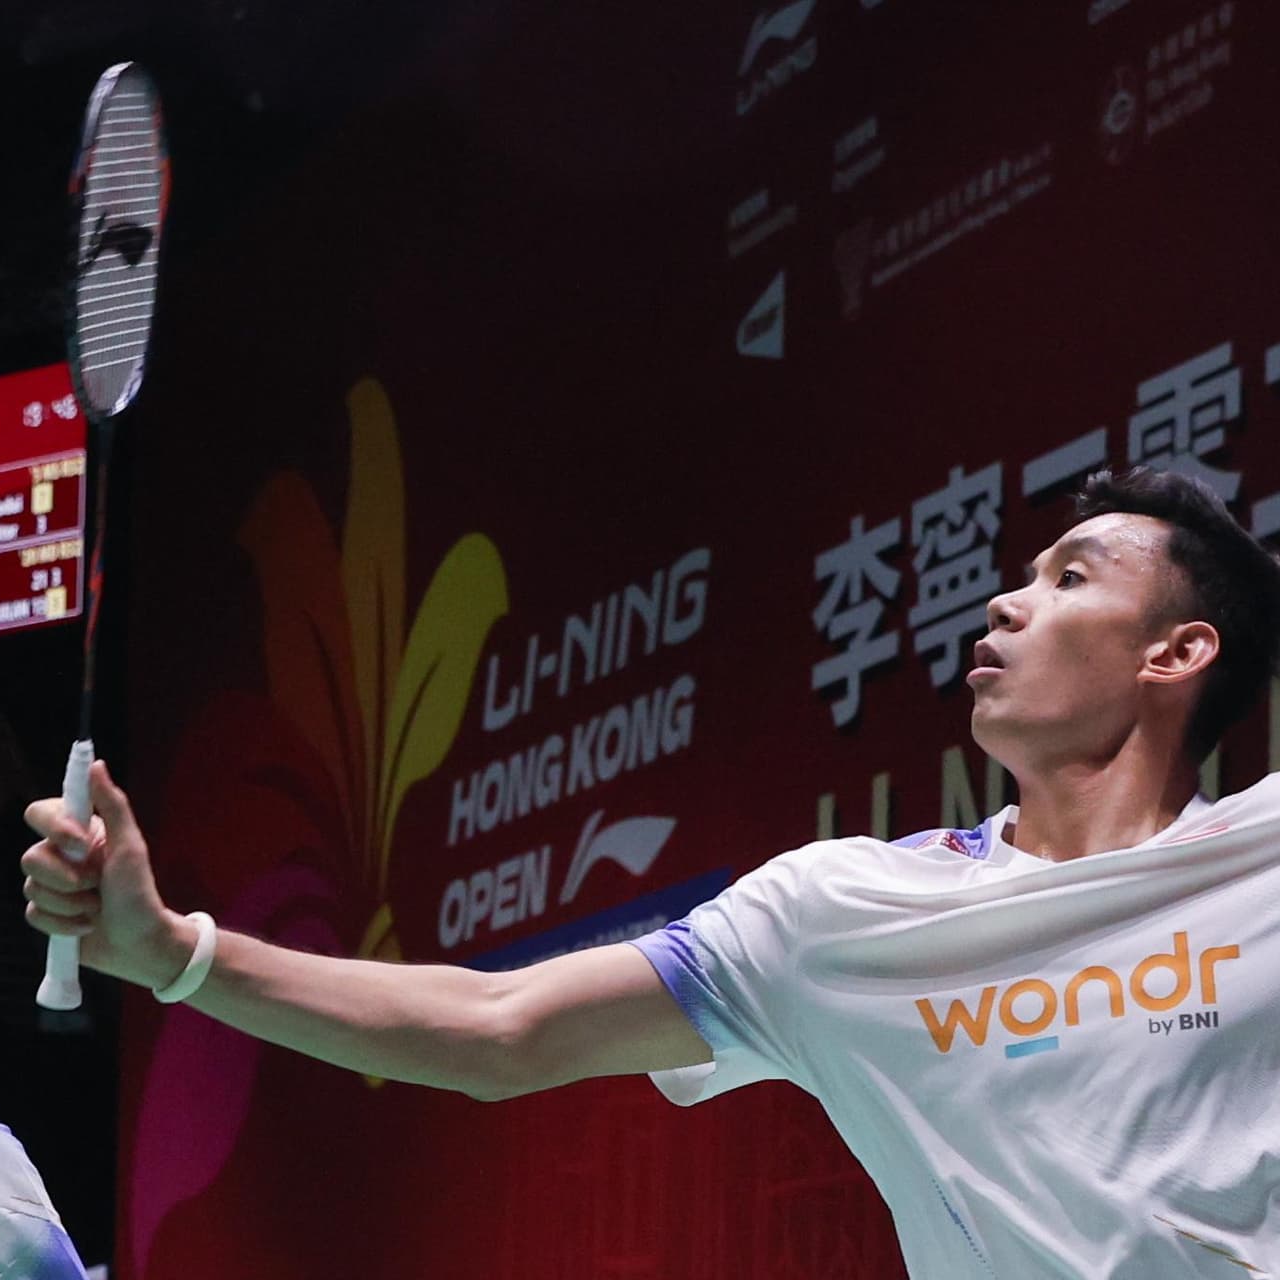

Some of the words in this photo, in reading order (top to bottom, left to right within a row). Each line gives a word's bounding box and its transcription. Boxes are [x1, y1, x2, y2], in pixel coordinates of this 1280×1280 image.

[482, 547, 712, 732] LI-NING
[448, 734, 565, 846] HONG
[566, 674, 697, 797] KONG
[438, 844, 552, 949] OPEN
[914, 930, 1240, 1054] wondr
[1148, 1016, 1174, 1036] by
[1179, 1011, 1220, 1031] BNI
